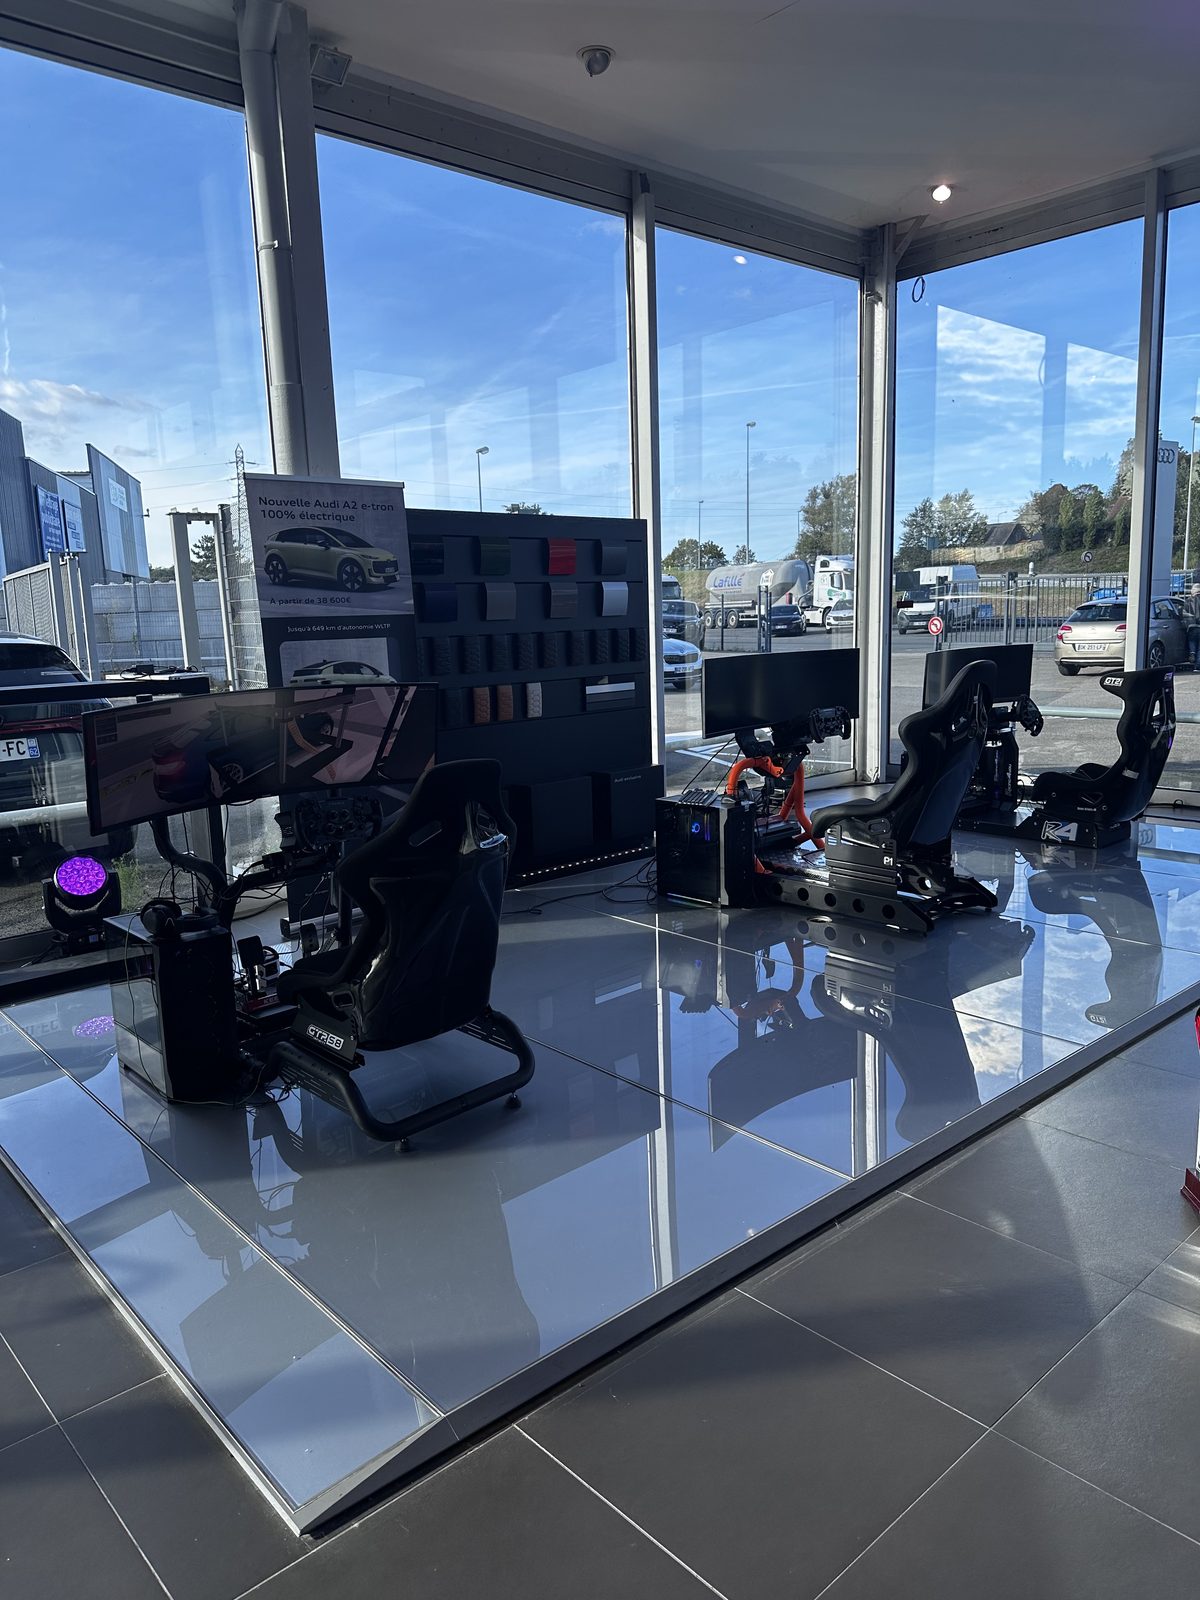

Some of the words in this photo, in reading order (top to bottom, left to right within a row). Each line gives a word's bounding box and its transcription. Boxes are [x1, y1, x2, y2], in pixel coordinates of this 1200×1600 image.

[258, 496, 311, 508] Nouvelle
[313, 499, 340, 509] Audi
[342, 501, 358, 510] A2
[361, 503, 394, 512] e-tron
[261, 509, 296, 520] 100%
[299, 511, 355, 523] électrique
[278, 597, 304, 606] partir
[305, 597, 315, 605] de
[287, 625, 311, 633] Jusqu'à
[29, 747, 39, 756] 62
[883, 856, 893, 866] P1
